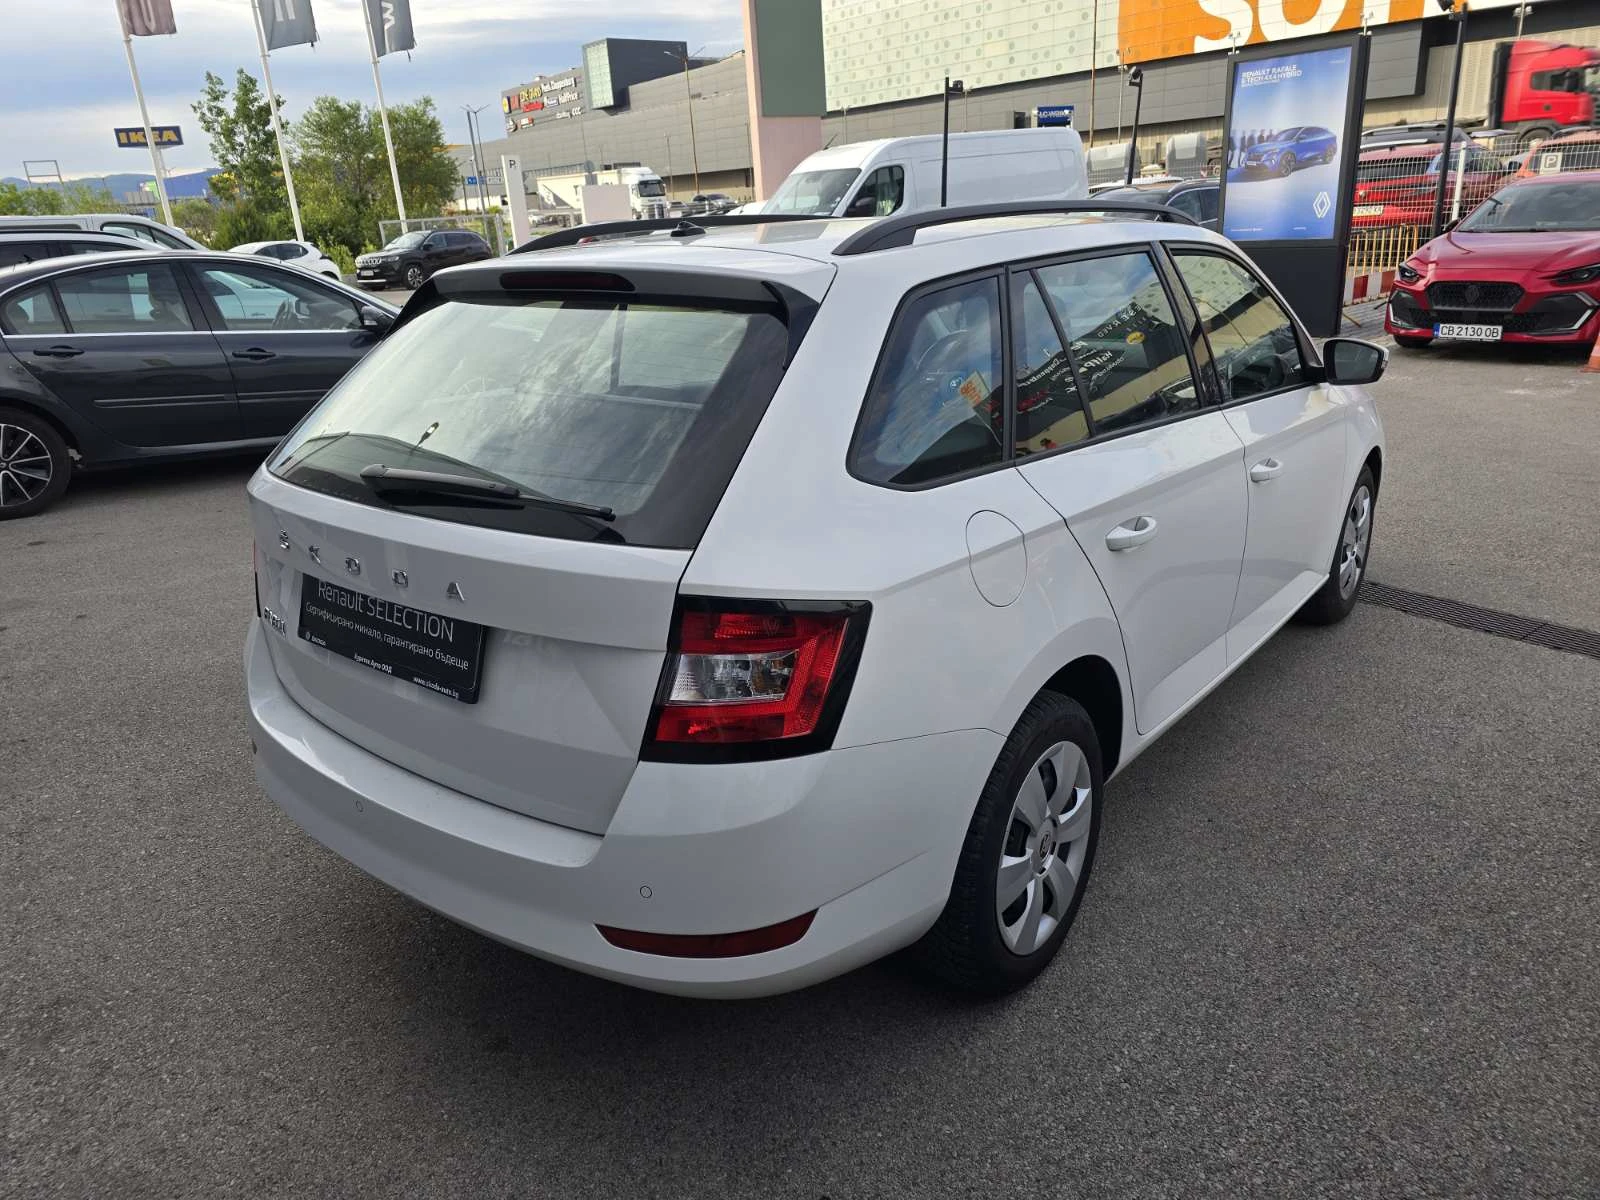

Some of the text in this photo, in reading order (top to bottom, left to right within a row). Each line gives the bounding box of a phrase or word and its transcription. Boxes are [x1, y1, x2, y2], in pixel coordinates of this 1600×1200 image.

[1545, 155, 1557, 168] P
[1441, 325, 1455, 336] CB
[1456, 326, 1483, 337] 2130
[318, 581, 454, 643] Renault SELECTION
[383, 632, 434, 659] гарантирано
[435, 648, 469, 671] бъдеще
